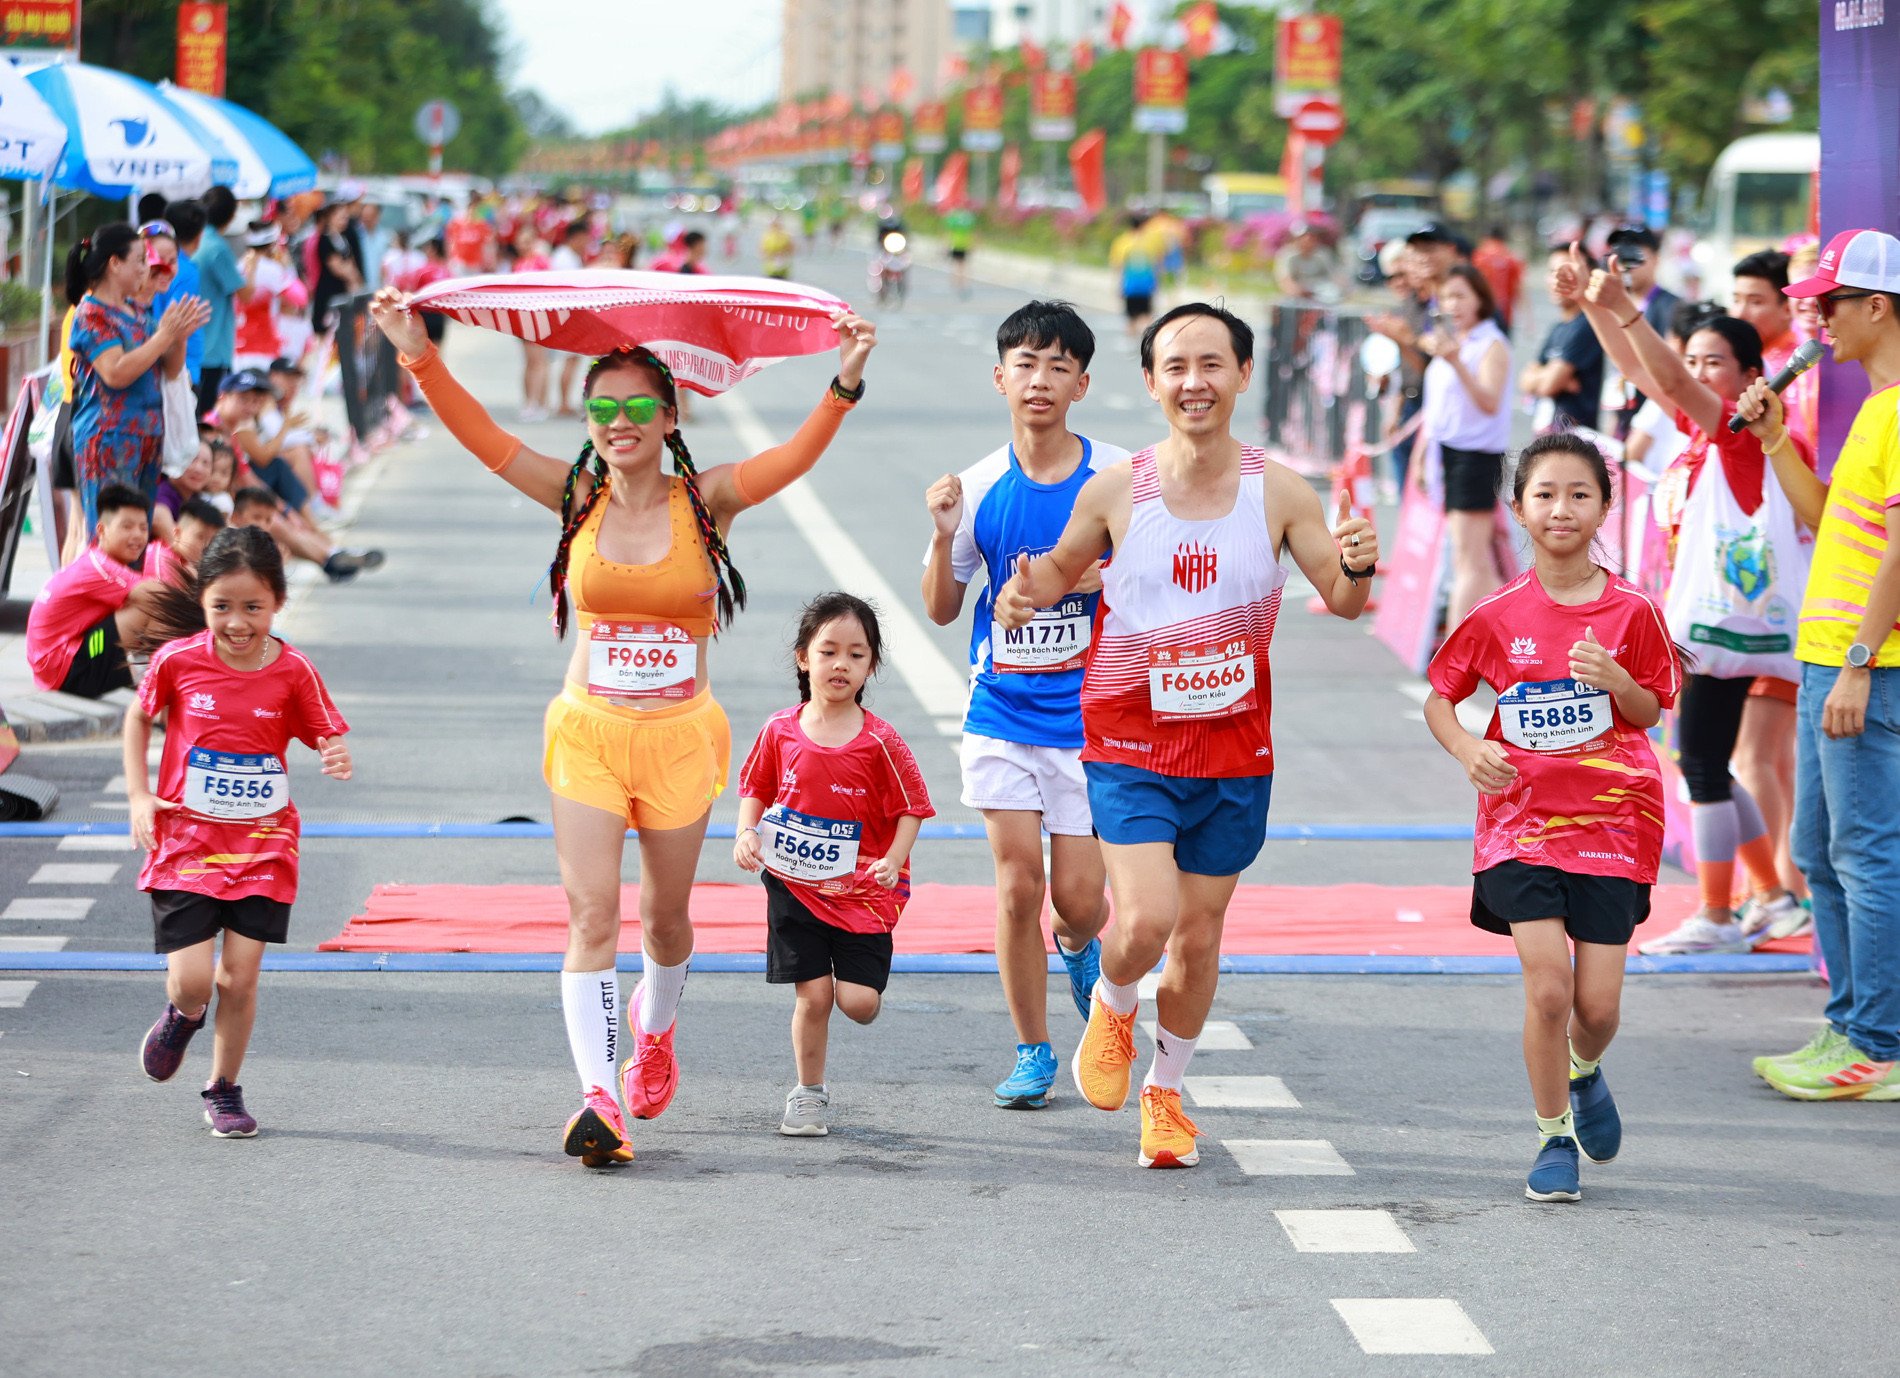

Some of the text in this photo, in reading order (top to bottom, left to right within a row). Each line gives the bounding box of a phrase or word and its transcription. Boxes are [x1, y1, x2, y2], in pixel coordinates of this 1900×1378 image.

[110, 159, 187, 180] VNPT
[666, 350, 725, 384] INSPIRATION
[1173, 552, 1217, 594] NAR
[1062, 601, 1077, 616] 10
[1005, 623, 1076, 645] M1771
[608, 647, 678, 668] F9696
[1032, 646, 1051, 654] Bách
[1226, 642, 1240, 658] 42
[1162, 663, 1245, 692] F66666
[1188, 692, 1208, 700] Loan
[1518, 703, 1593, 729] F5885
[1523, 725, 1594, 739] Hoàng Khánh Linh
[204, 775, 274, 799] F5556
[774, 831, 840, 862] F5665
[606, 1027, 618, 1062] WANT
